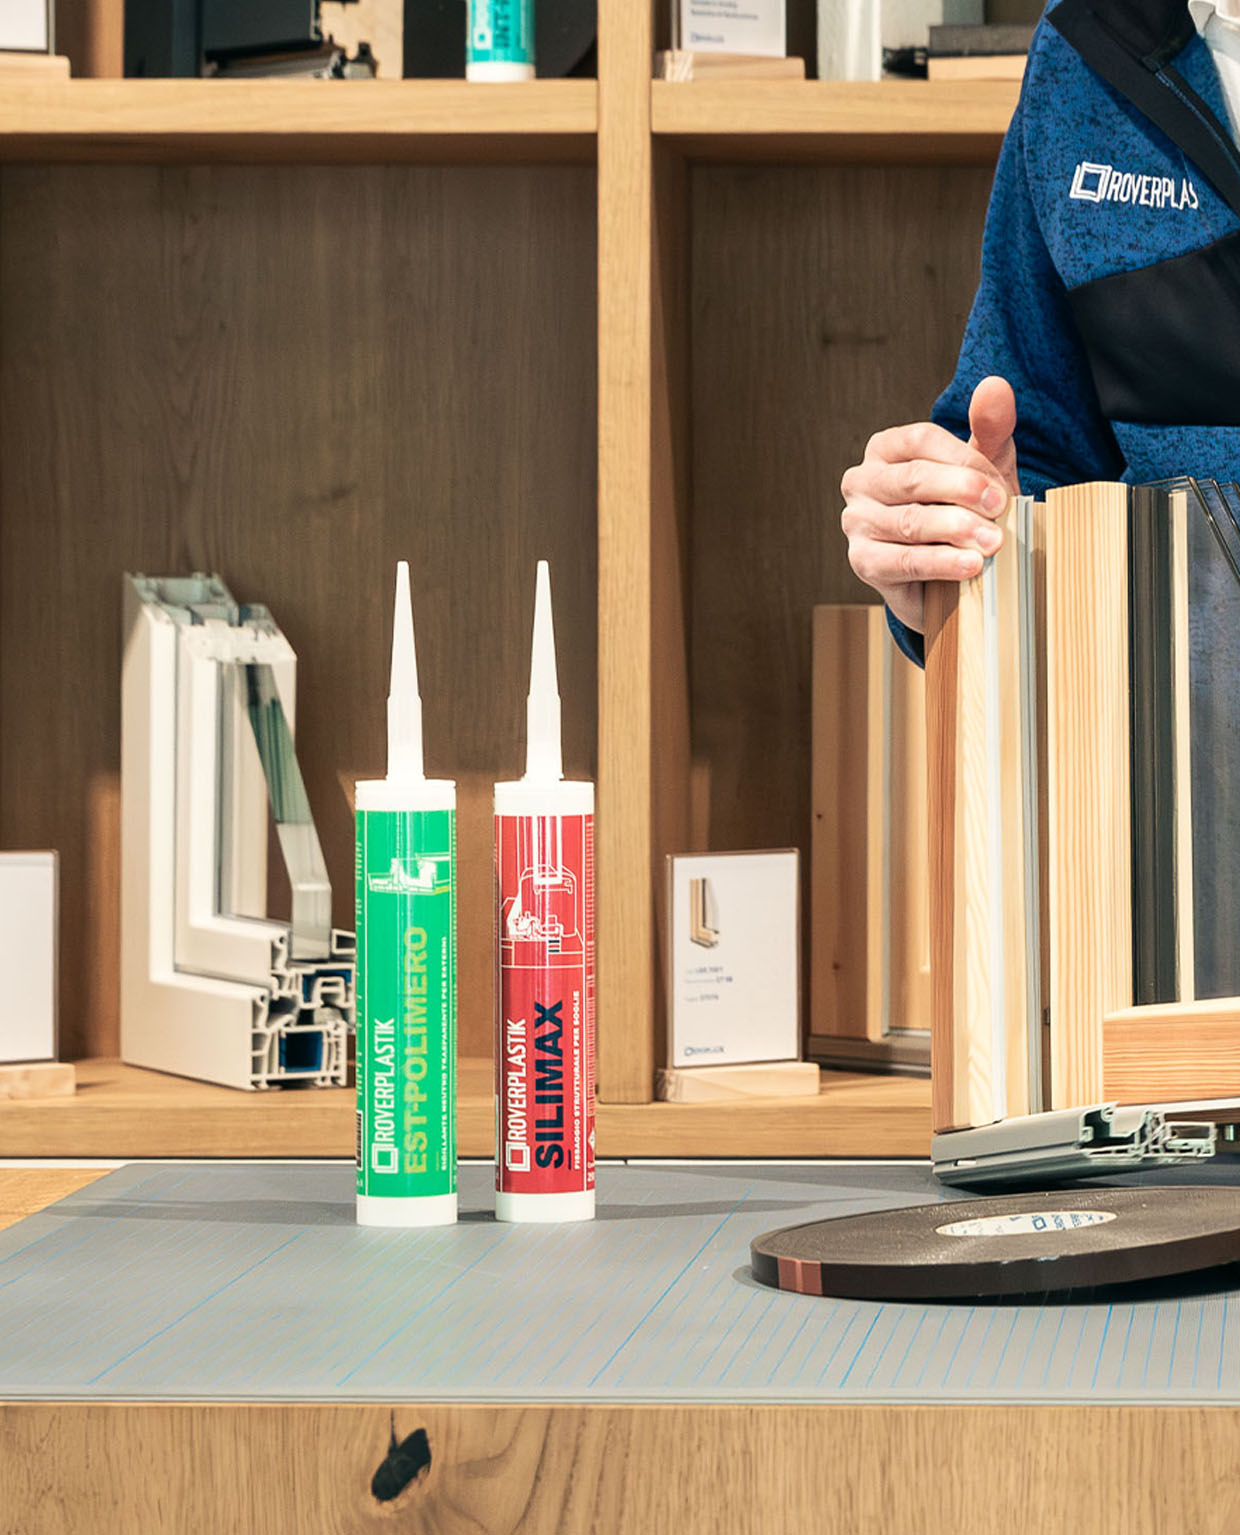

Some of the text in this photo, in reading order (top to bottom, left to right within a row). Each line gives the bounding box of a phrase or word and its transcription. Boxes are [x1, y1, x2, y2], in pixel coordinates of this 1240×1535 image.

[374, 1018, 395, 1142] ROVERPLASTIK
[403, 926, 428, 1174] EST-POLIMERO
[507, 1018, 526, 1141] ROVERPLASTIK
[534, 1000, 564, 1169] SILIMAX
